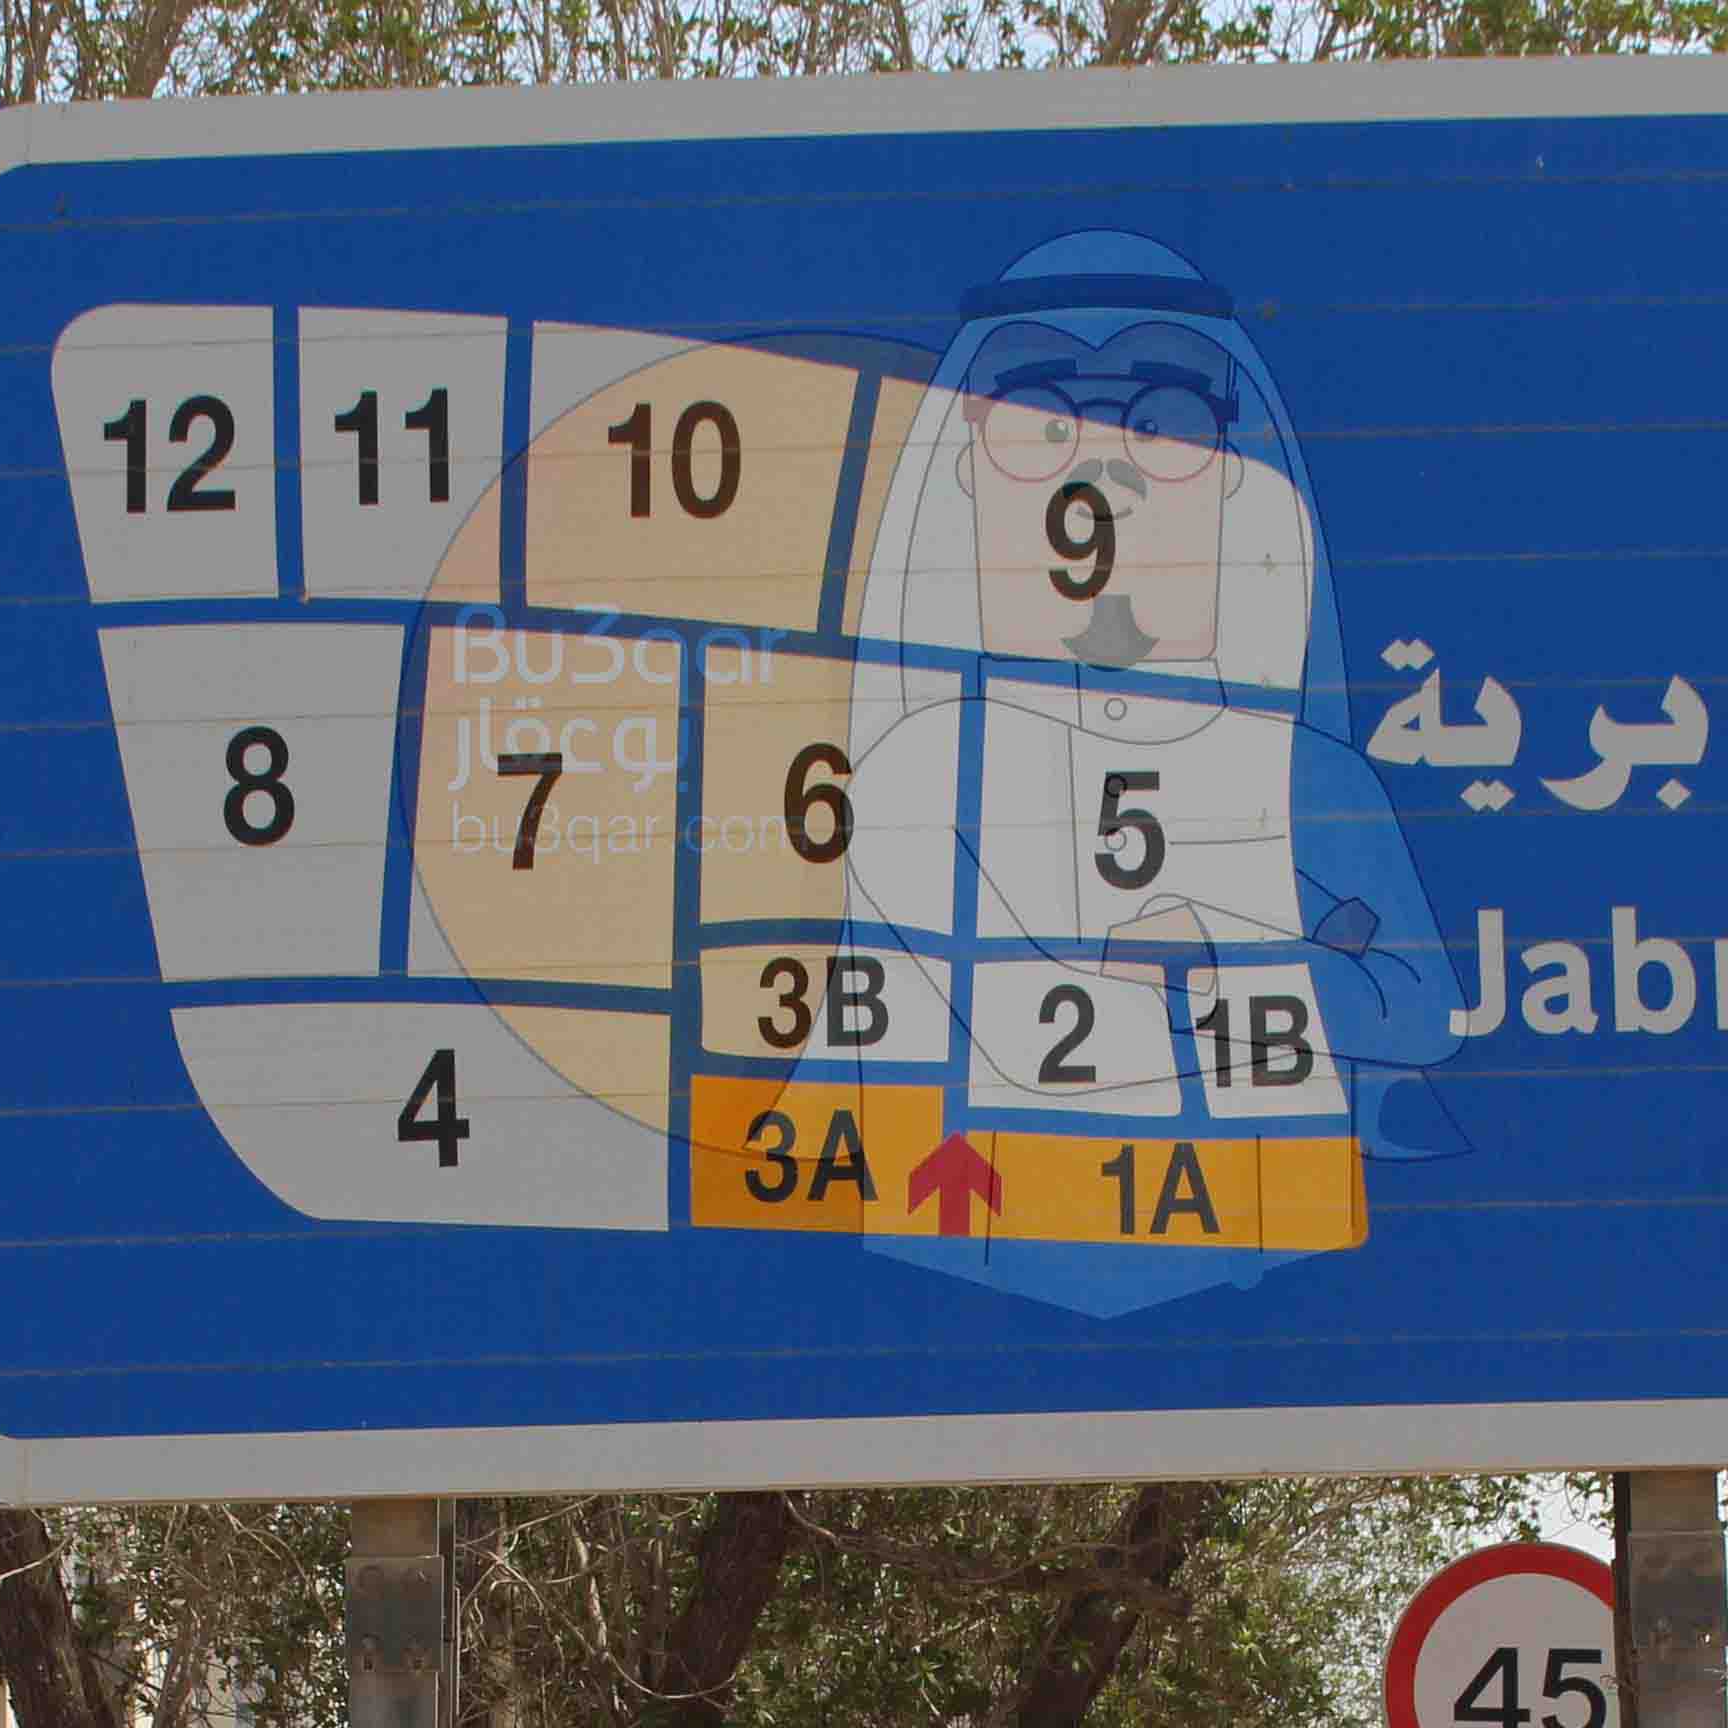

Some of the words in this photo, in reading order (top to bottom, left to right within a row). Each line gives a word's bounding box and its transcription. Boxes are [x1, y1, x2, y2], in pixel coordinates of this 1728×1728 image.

[104, 395, 237, 514] 12
[335, 387, 449, 506] 11
[607, 400, 742, 520] 10
[1044, 481, 1117, 601] 9
[222, 726, 296, 846] 8
[496, 751, 564, 870] 7
[783, 743, 854, 865] 6
[1094, 770, 1166, 889] 5
[757, 954, 890, 1050] 3B
[1036, 985, 1098, 1084] 2
[1195, 995, 1315, 1089] 1B
[396, 1048, 470, 1168] 4
[743, 1110, 879, 1204] 3A
[1100, 1142, 1221, 1235] 1A
